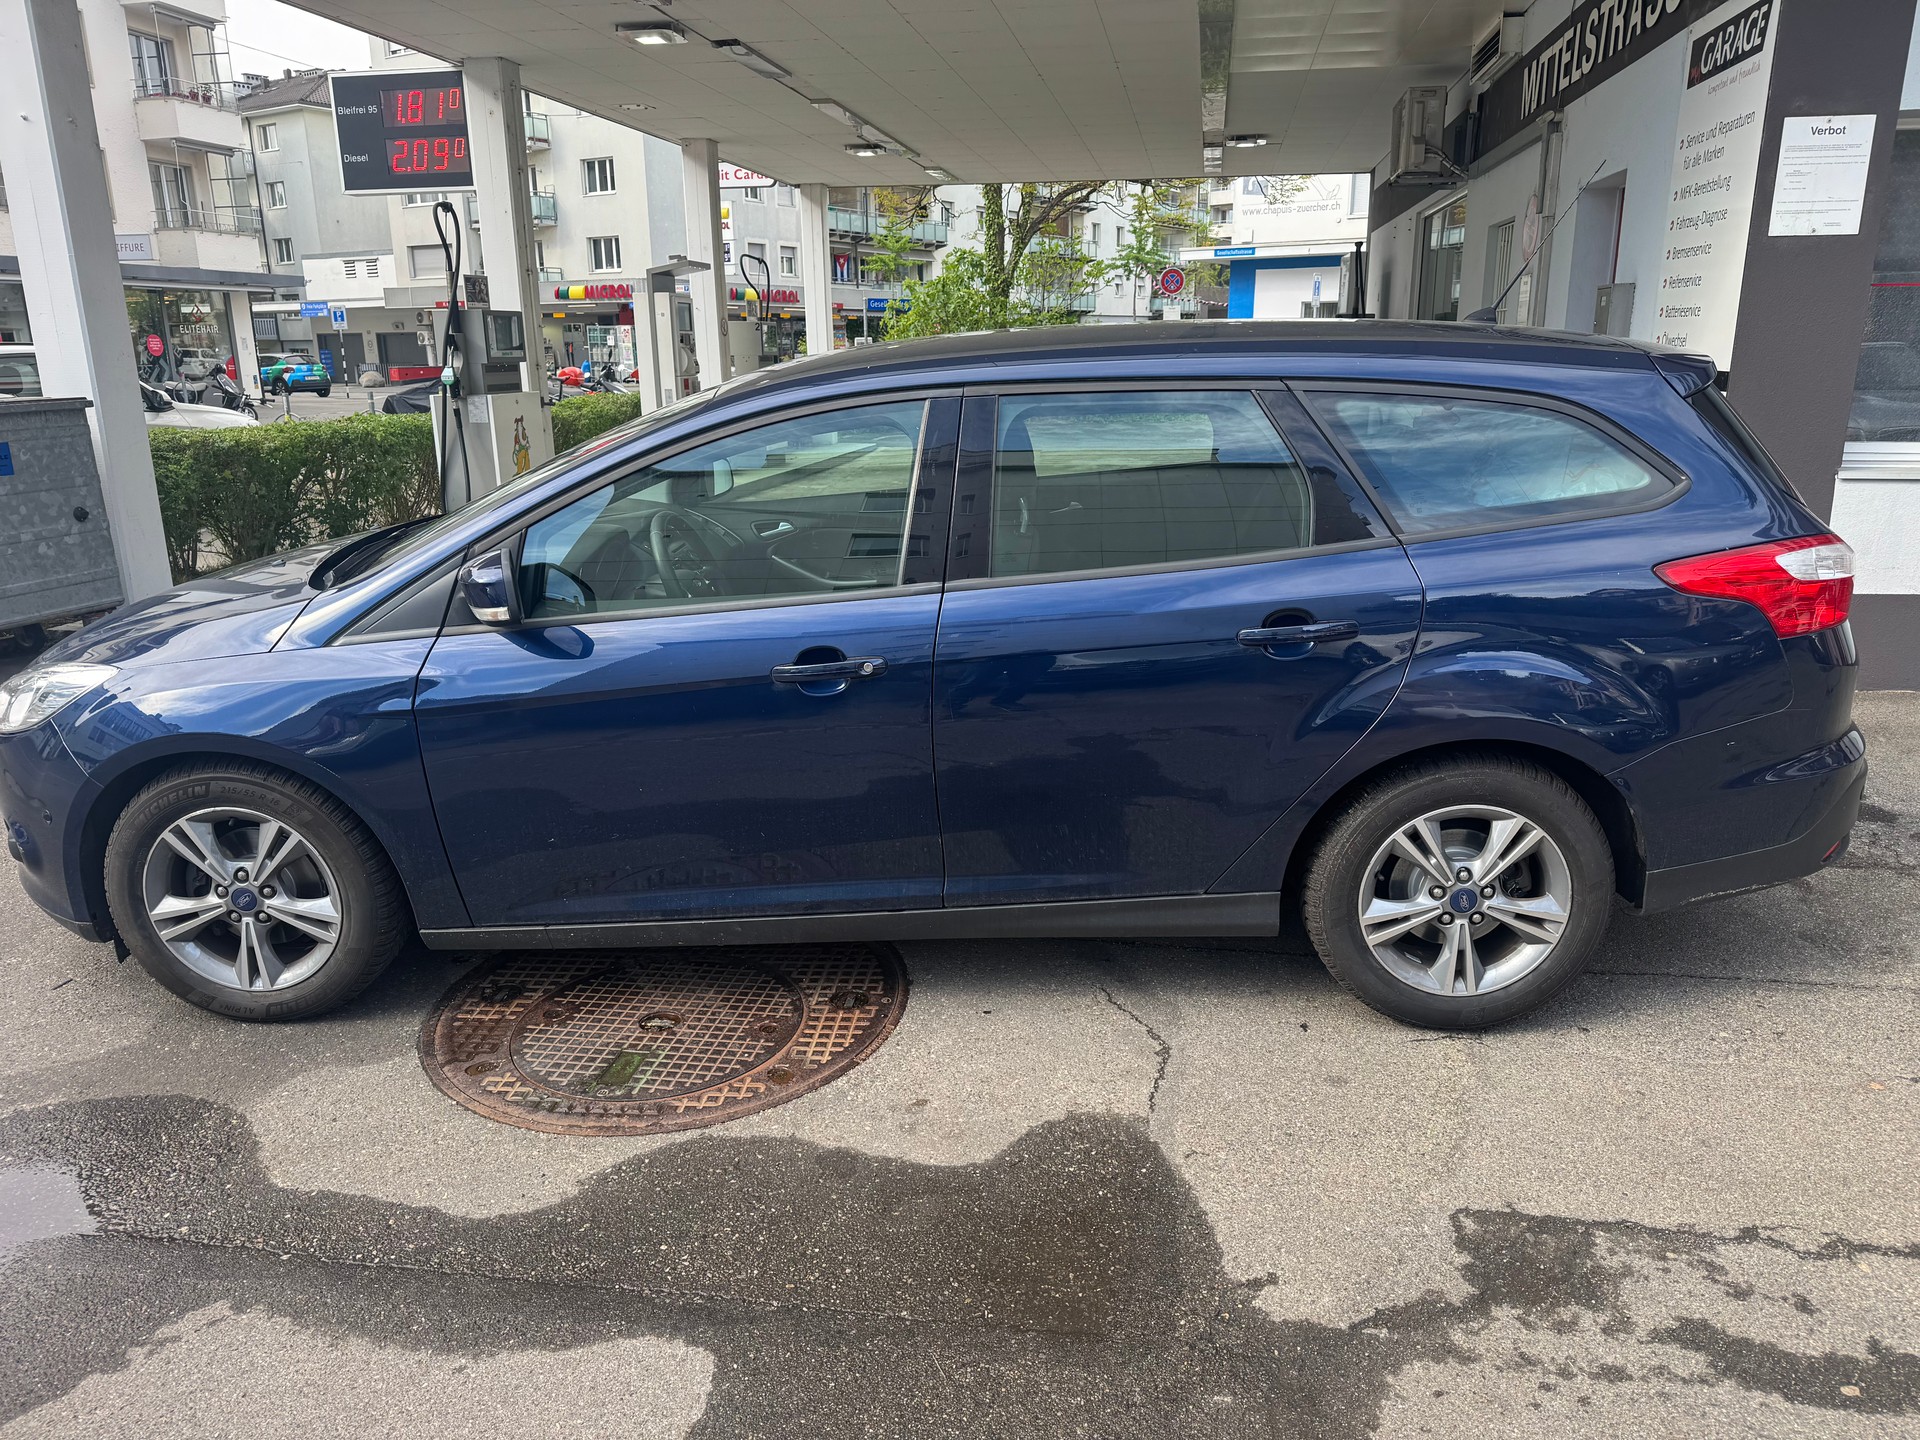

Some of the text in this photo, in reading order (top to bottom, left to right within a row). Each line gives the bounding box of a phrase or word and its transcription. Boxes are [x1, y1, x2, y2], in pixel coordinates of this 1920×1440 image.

[1700, 3, 1769, 74] GARAGE
[1521, 0, 1681, 120] MITTELSTRA
[338, 106, 366, 115] Bleifrei
[368, 105, 378, 114] 95
[1685, 111, 1756, 149] Service und Reparaturen
[1811, 126, 1847, 136] Verbot
[344, 154, 369, 163] Diesel
[1683, 145, 1725, 171] für alle Marken
[1679, 174, 1732, 201] MFK-Bereitstellung
[1242, 201, 1341, 216] www.chapuis-zuercher.ch
[1676, 208, 1728, 230] Fahrzeug-Diagnose
[1672, 241, 1712, 260] Bremsenservice
[1668, 273, 1702, 289] Reifenservice
[585, 284, 632, 299] MIGROL
[1665, 304, 1702, 318] Batterieservice
[180, 324, 219, 334] ELITEHAIR
[755, 323, 760, 331] 2
[221, 786, 280, 806] 215/55 R 16
[134, 785, 206, 828] MICHELIN
